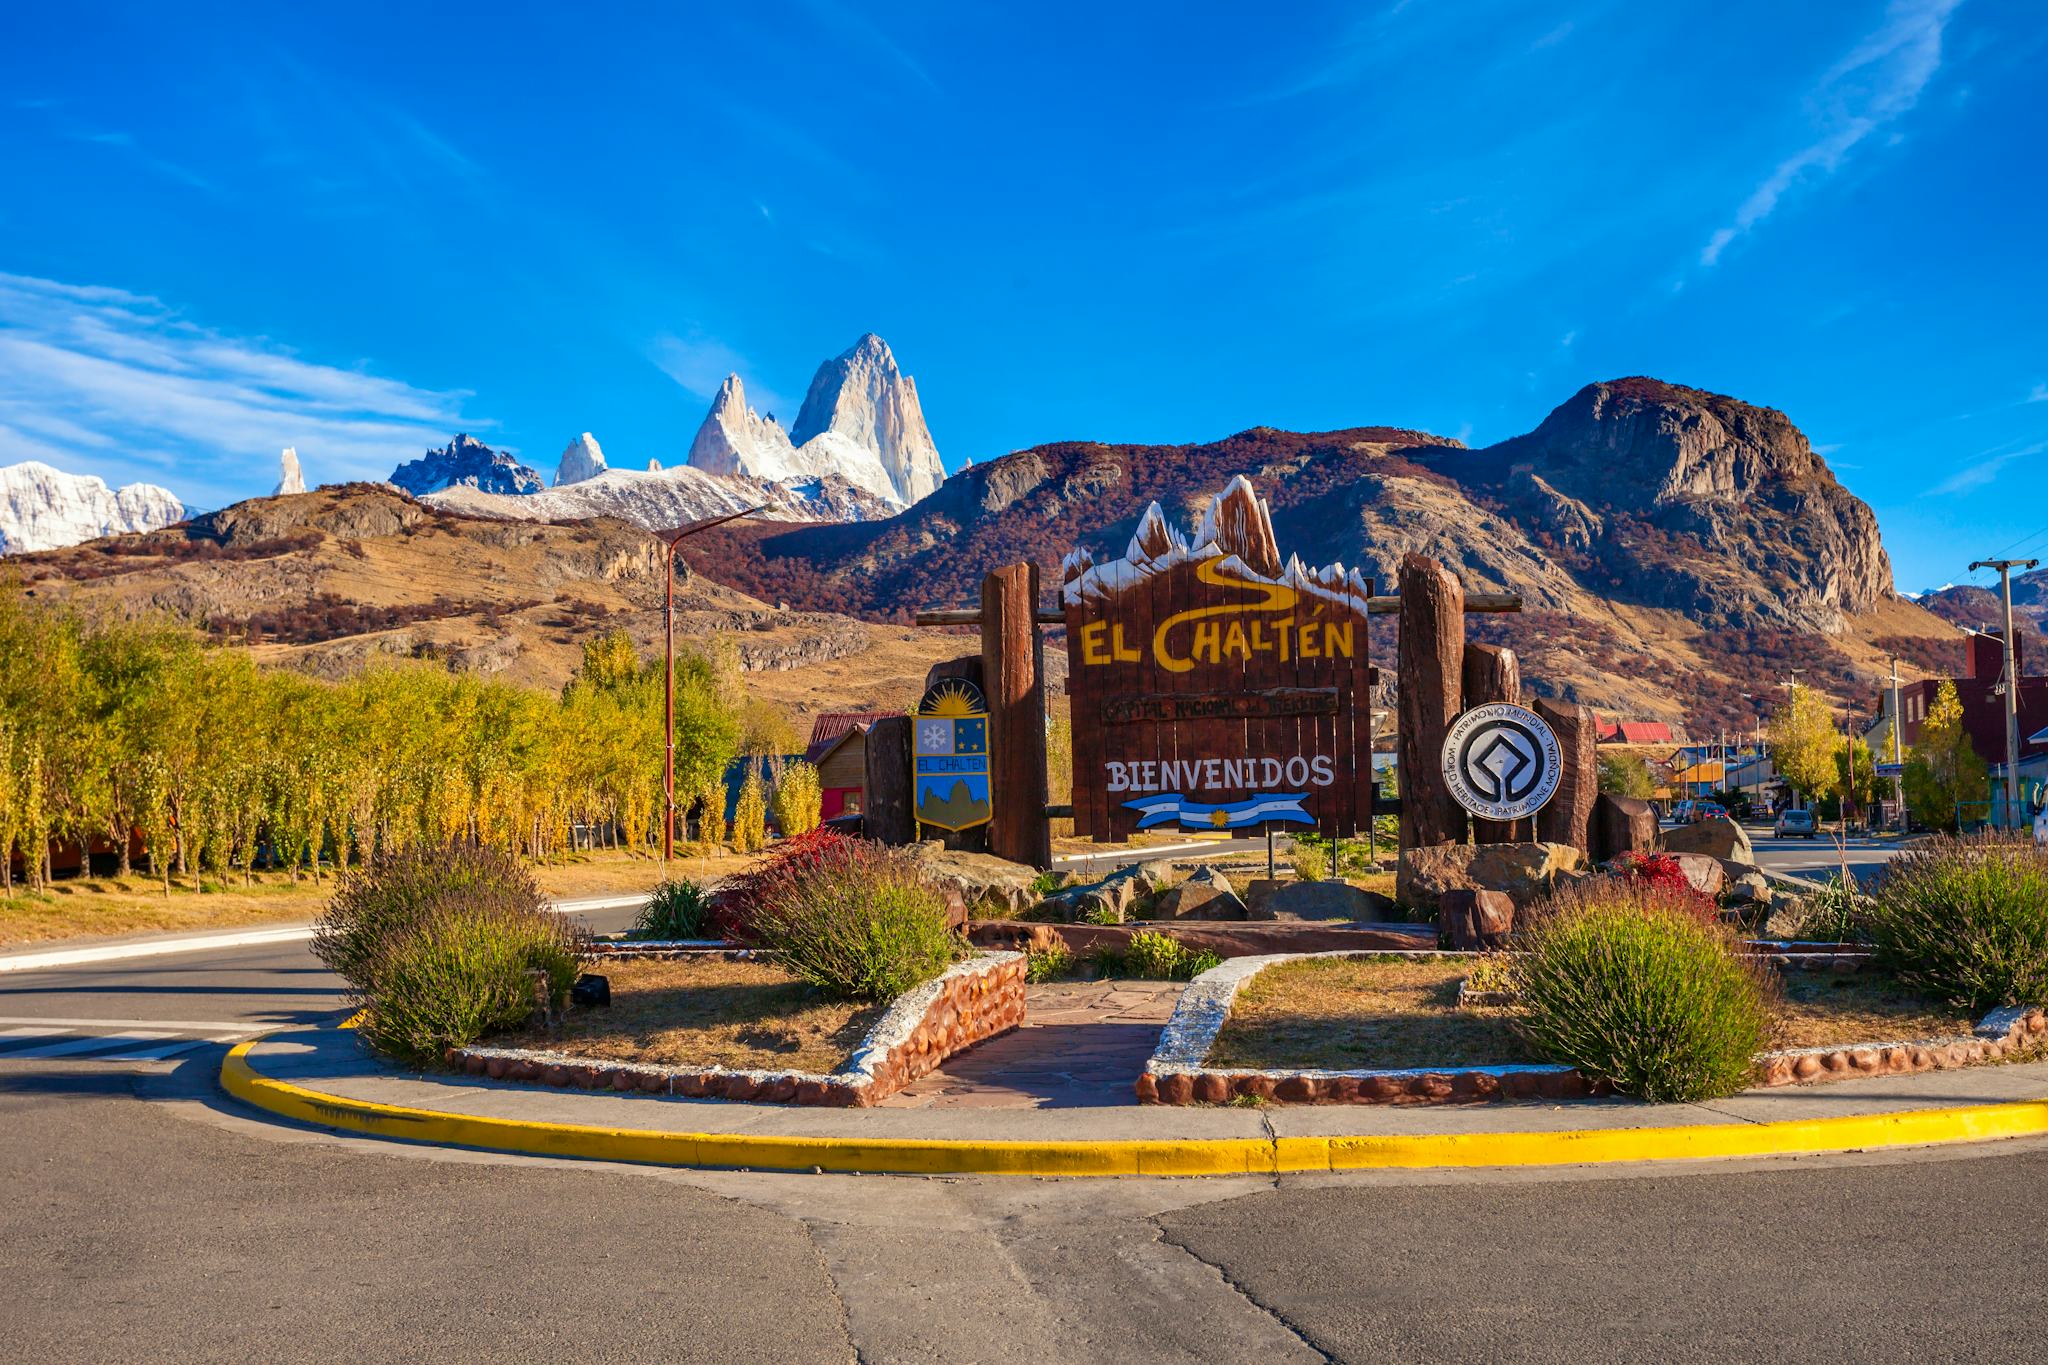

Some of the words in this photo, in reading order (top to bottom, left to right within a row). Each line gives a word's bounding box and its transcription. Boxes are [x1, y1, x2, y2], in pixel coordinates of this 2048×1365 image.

[1080, 619, 1142, 666] EL
[1152, 604, 1354, 673] CHALTÉN
[1453, 707, 1505, 741] PATRIMONIO
[1508, 708, 1546, 738] MUNDIAL
[918, 760, 933, 771] EL
[939, 758, 986, 771] CHALTEN
[1105, 755, 1336, 792] BIENVENIDOS
[1447, 747, 1458, 781] WORLD
[1453, 783, 1490, 814] HERITAGE
[1497, 787, 1549, 815] PATRIMOINE
[1546, 740, 1558, 786] MONDIAL
